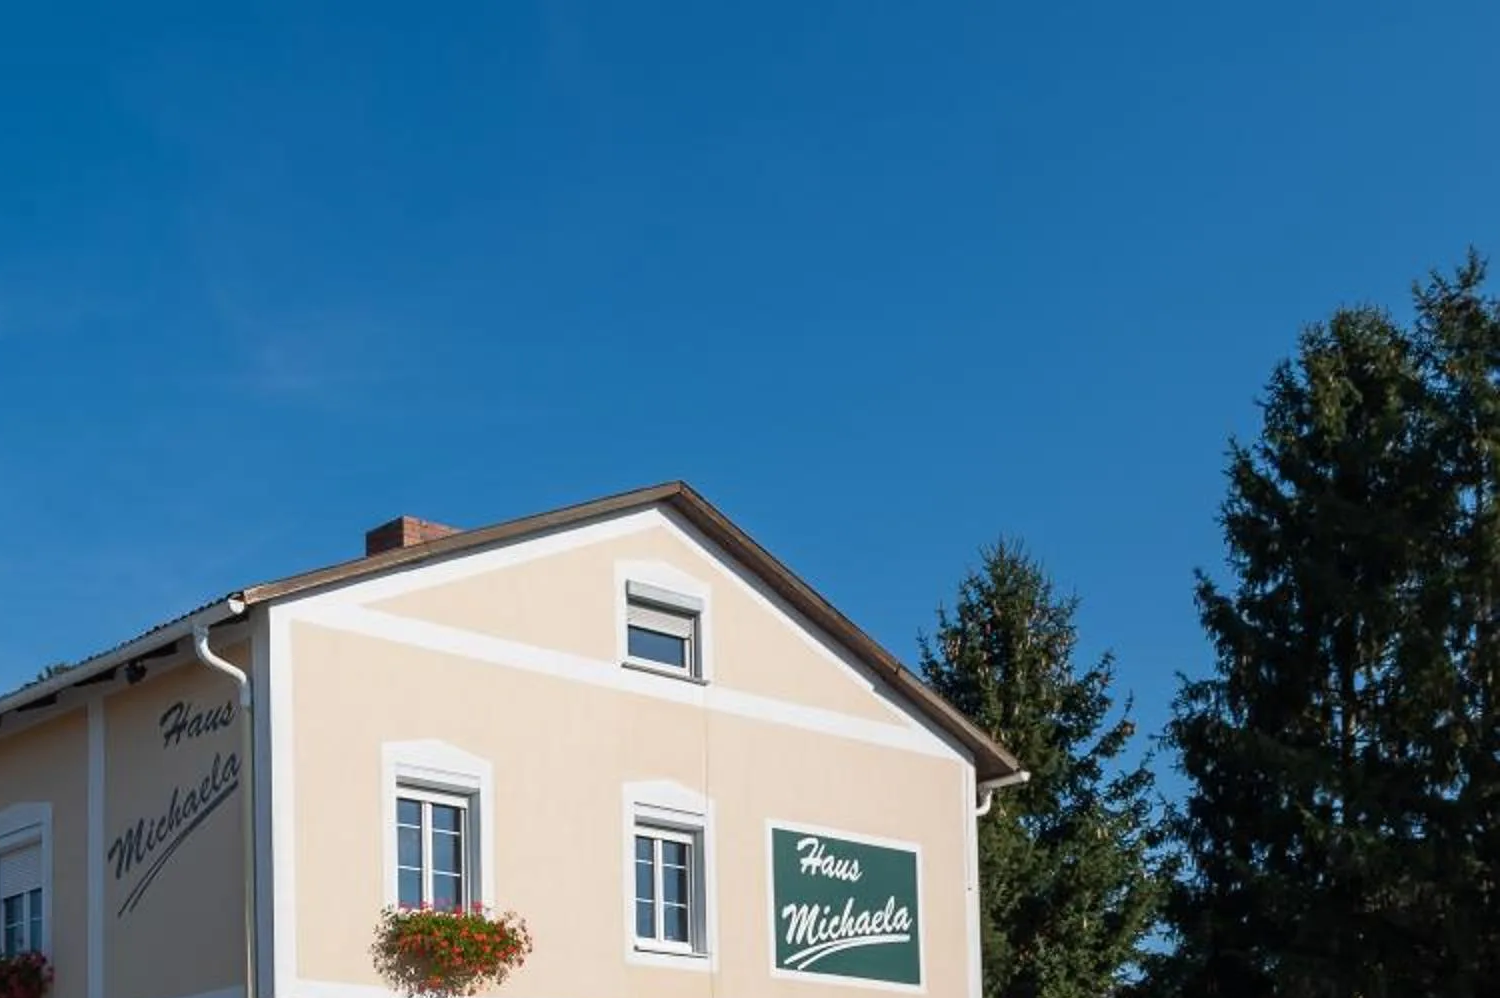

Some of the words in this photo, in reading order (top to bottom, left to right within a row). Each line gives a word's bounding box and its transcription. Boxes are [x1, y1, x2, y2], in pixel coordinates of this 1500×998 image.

[158, 701, 236, 748] Haus
[107, 752, 242, 880] Michaela
[796, 837, 863, 882] Haus
[781, 896, 913, 945] Michaela
